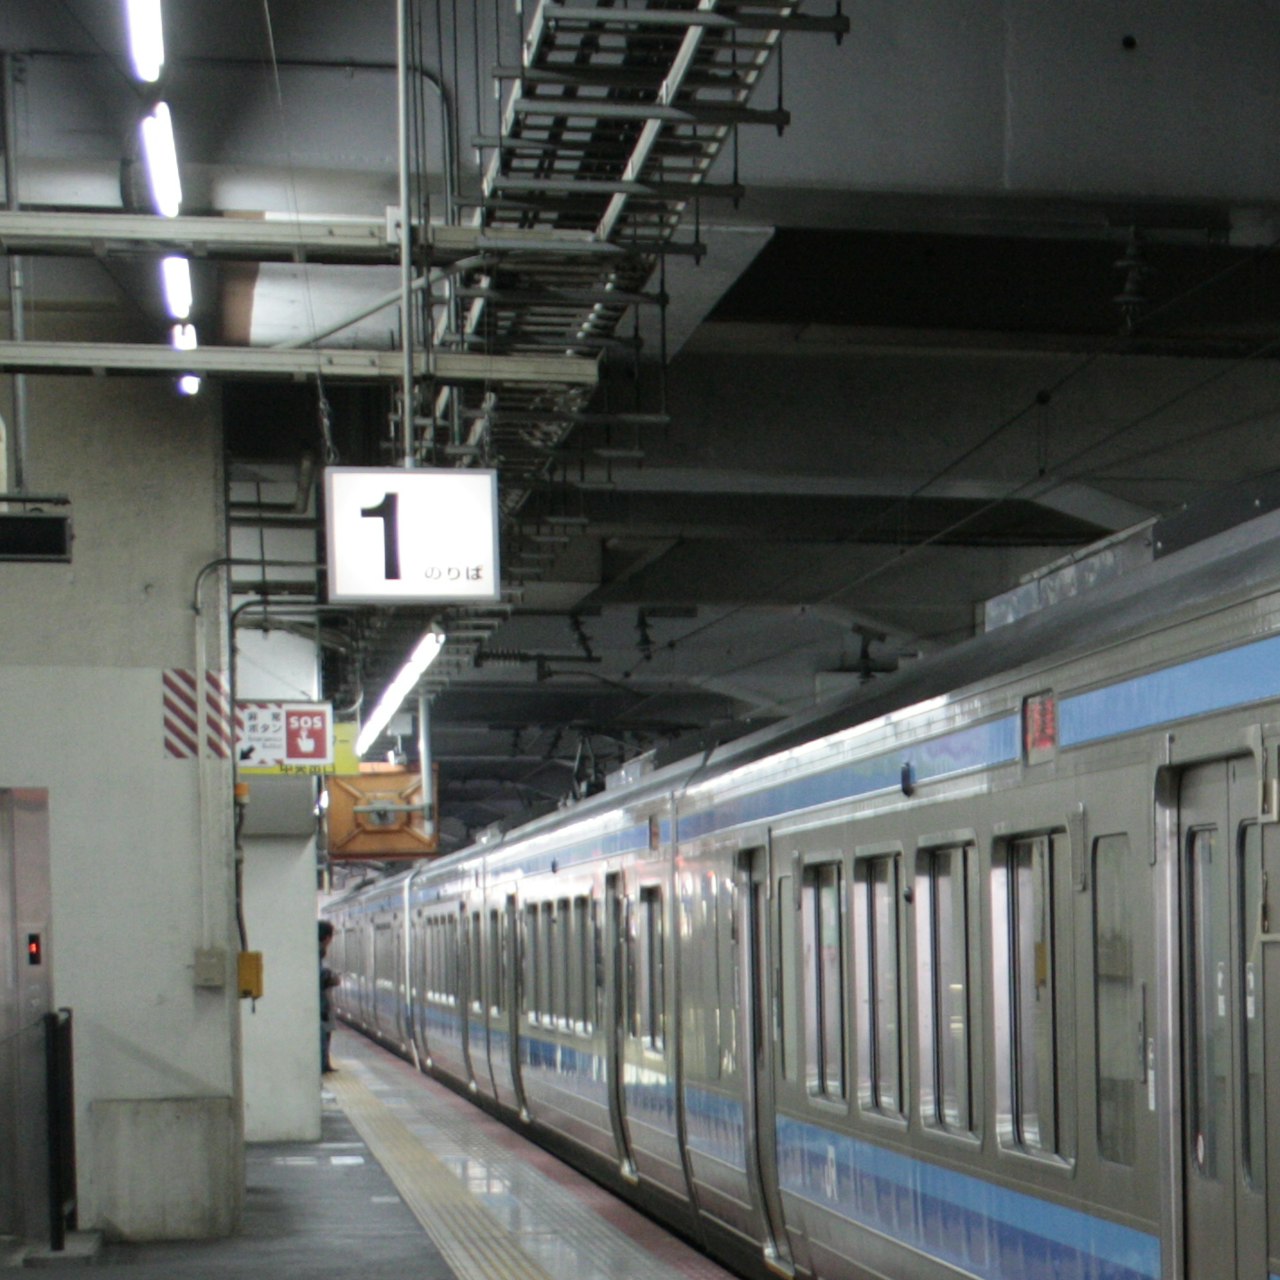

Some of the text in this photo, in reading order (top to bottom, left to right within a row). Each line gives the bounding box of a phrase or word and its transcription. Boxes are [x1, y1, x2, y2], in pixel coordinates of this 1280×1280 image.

[360, 492, 483, 581] 1 のりば
[289, 715, 323, 729] SOS
